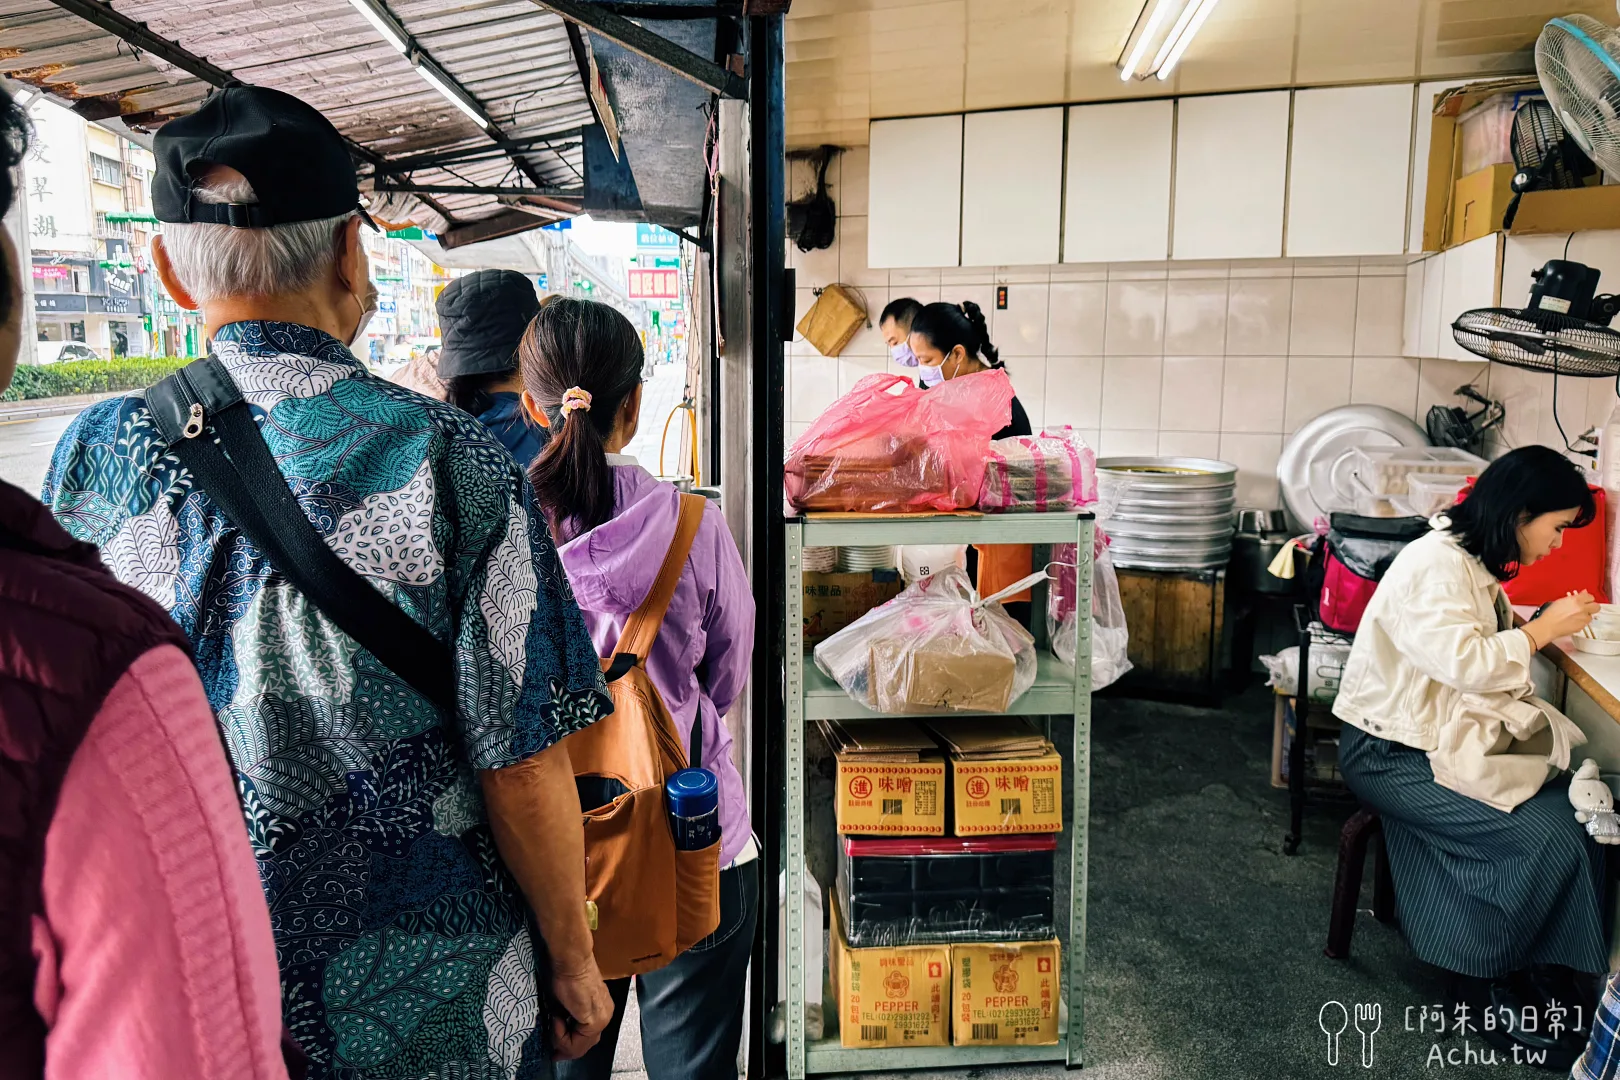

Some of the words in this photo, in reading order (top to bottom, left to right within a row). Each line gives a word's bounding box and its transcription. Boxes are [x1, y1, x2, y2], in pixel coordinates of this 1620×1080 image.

[802, 585, 841, 597] 味聖品
[875, 1001, 919, 1012] PEPPER
[985, 995, 1029, 1008] PEPPER
[894, 1021, 930, 1029] 29931622
